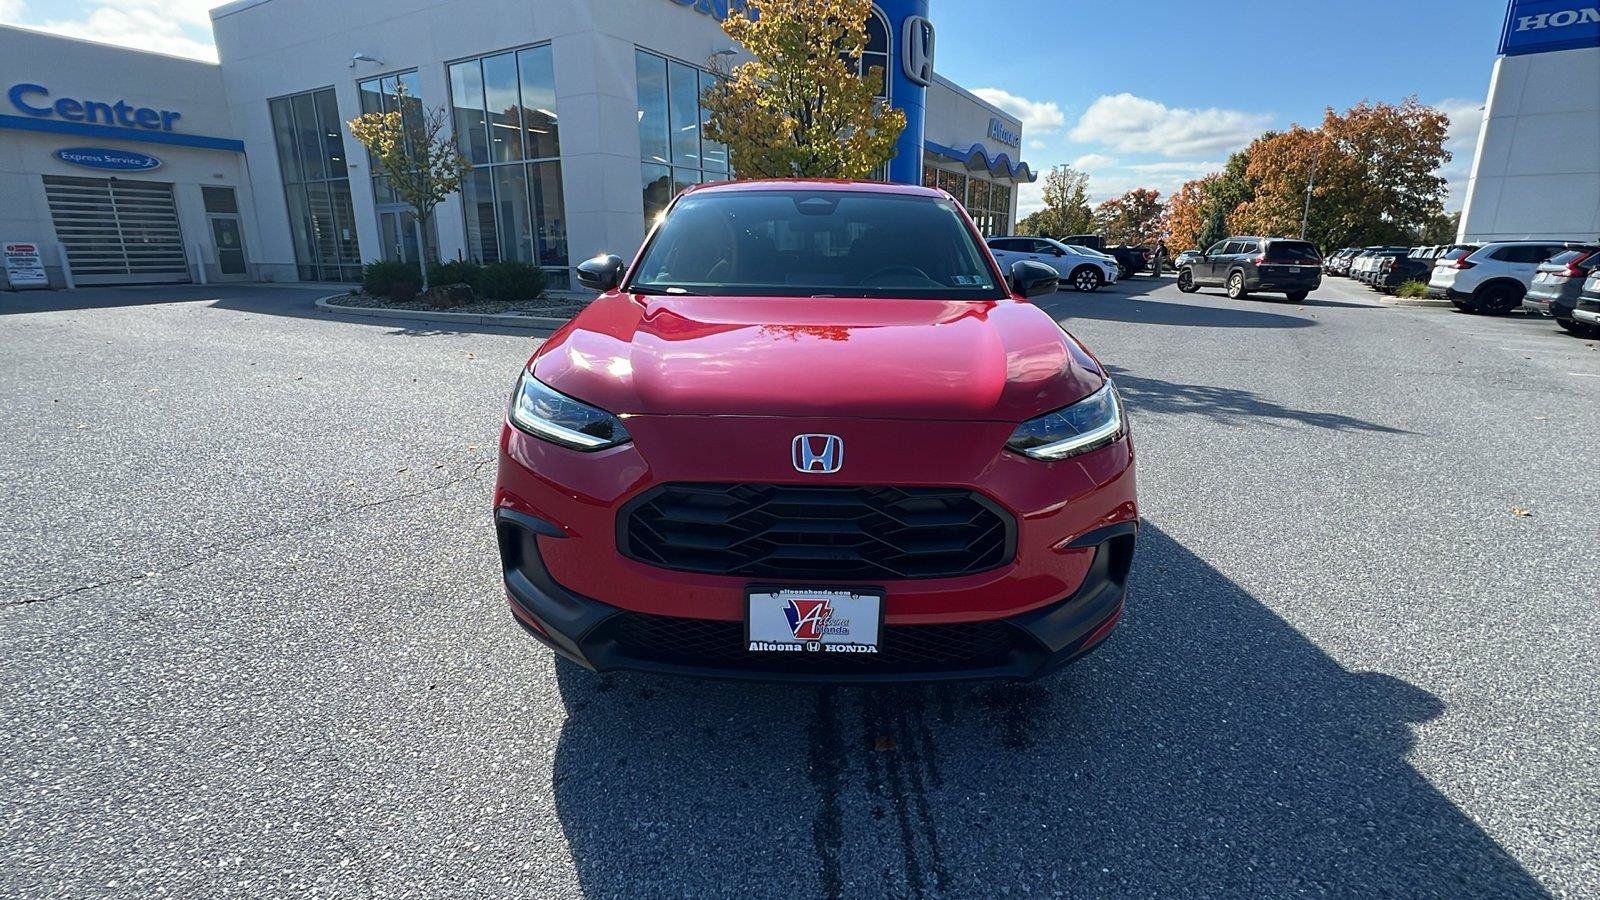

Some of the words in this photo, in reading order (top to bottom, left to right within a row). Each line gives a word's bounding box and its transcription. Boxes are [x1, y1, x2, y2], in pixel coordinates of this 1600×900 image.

[7, 83, 182, 131] Center
[987, 117, 1020, 148] Altoona
[61, 151, 102, 163] Express
[104, 154, 141, 165] Service
[779, 588, 851, 596] altoonahonda.com
[816, 625, 850, 635] Honda
[748, 641, 803, 652] Altoona
[824, 643, 878, 653] HONDA
